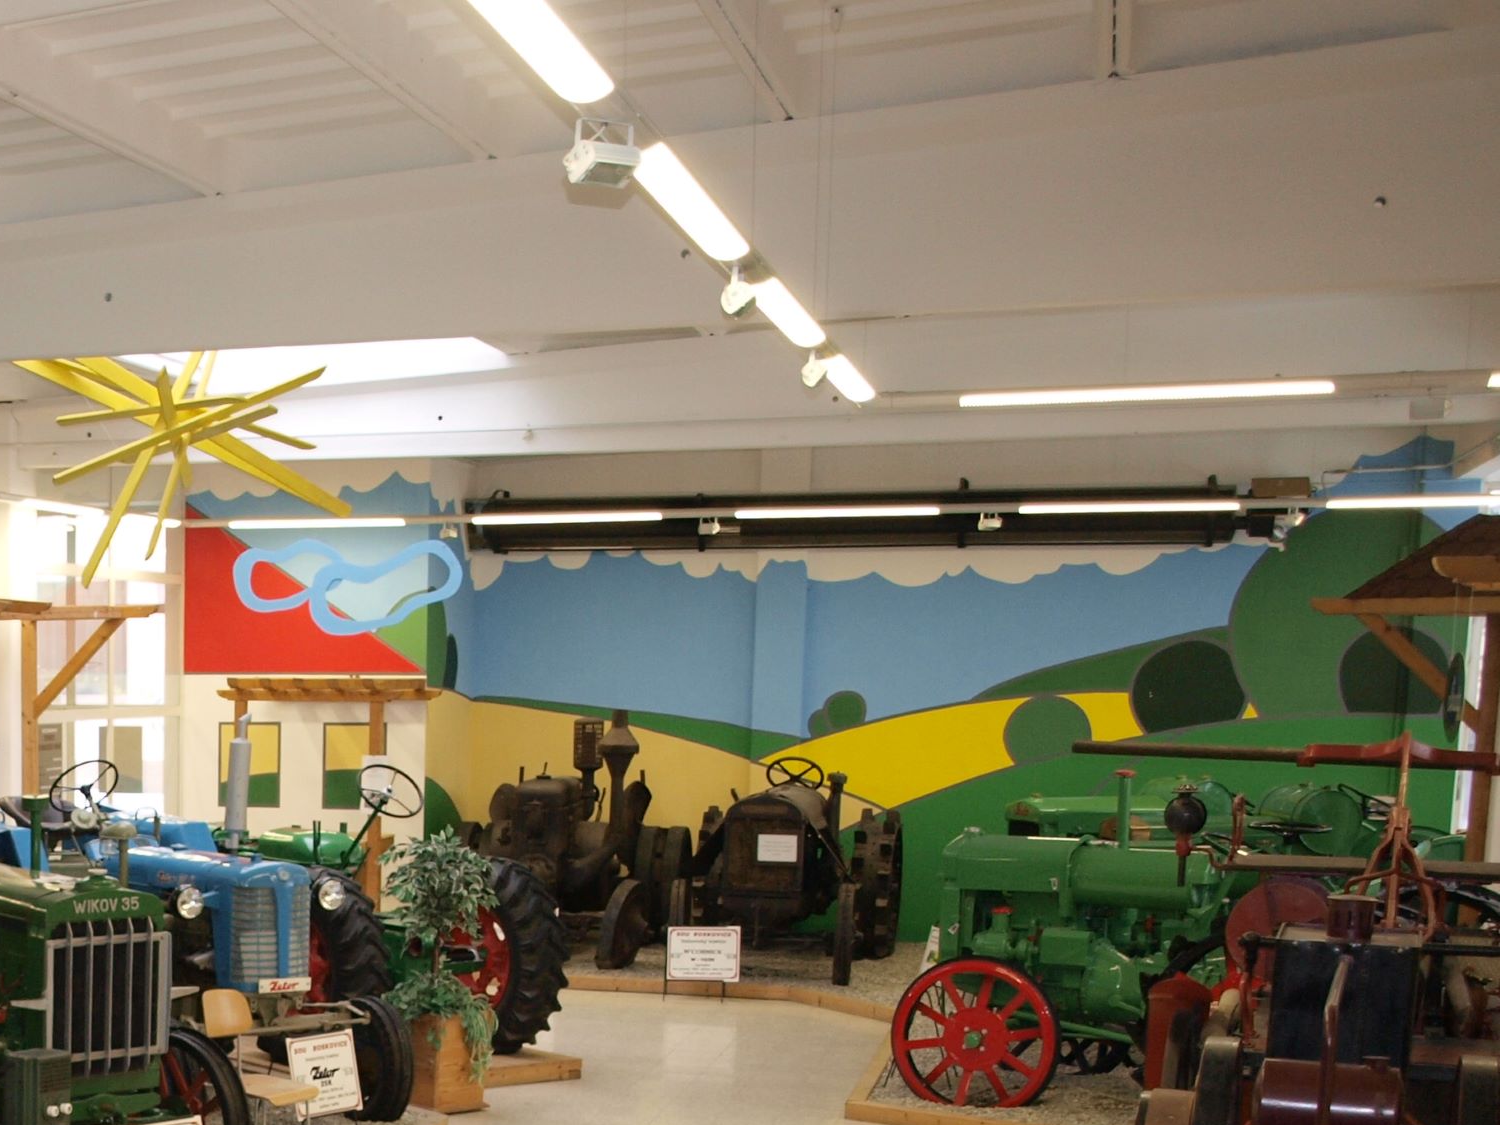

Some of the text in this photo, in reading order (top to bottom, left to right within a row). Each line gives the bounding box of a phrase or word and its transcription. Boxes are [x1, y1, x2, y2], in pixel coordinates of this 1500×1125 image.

[73, 896, 140, 914] WIKOV 35
[269, 980, 299, 991] Zetor
[309, 1065, 341, 1080] Zetor
